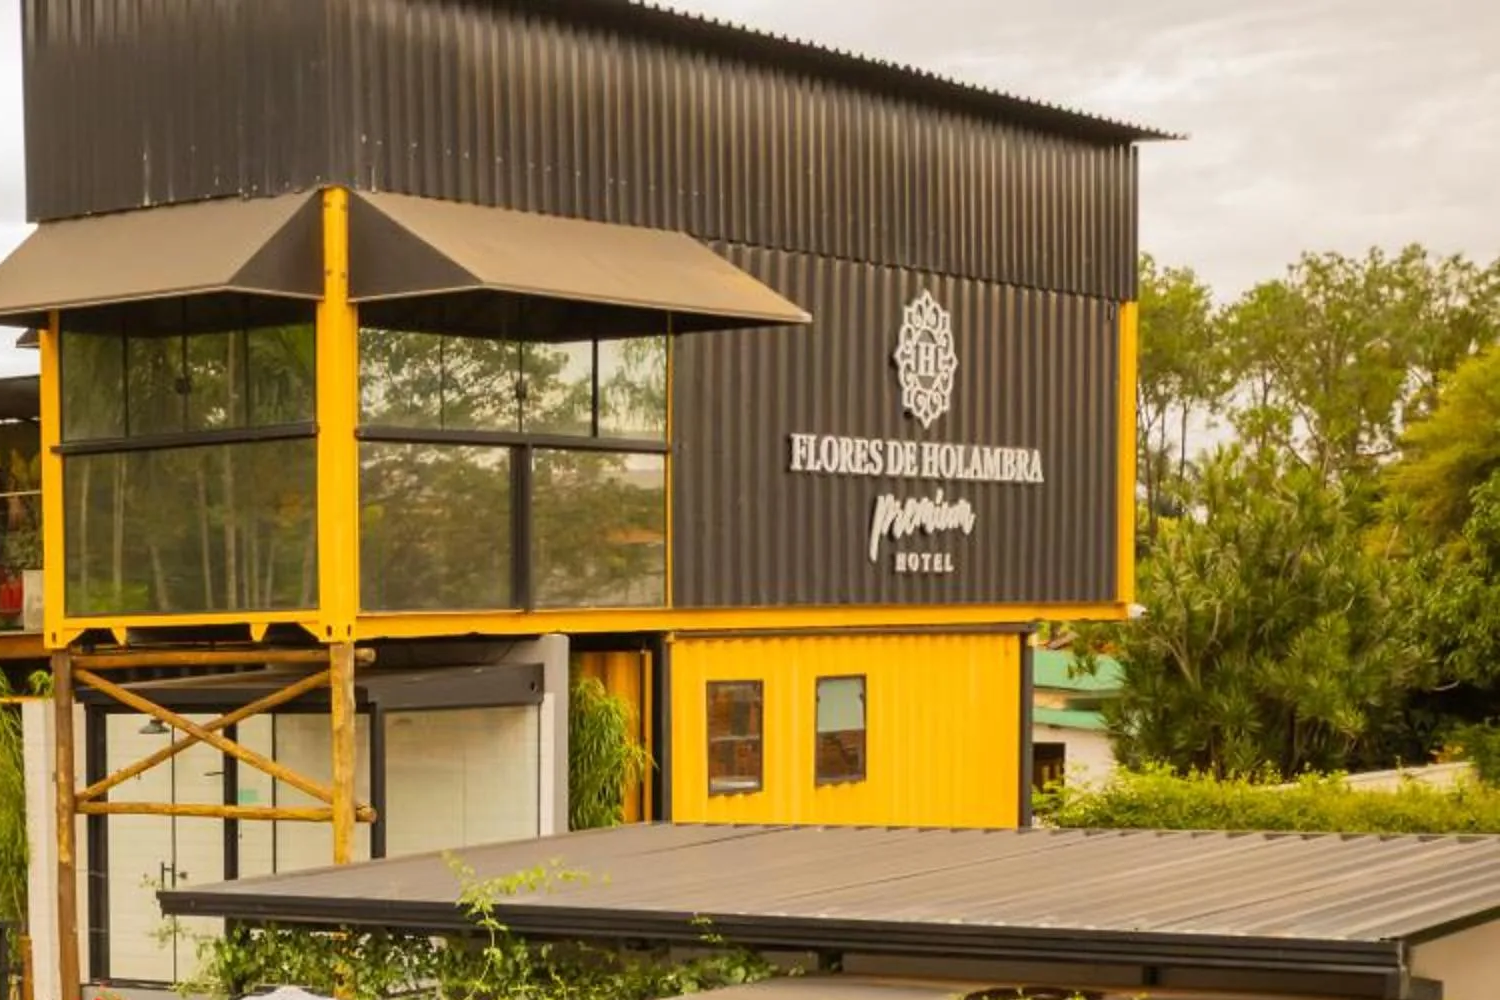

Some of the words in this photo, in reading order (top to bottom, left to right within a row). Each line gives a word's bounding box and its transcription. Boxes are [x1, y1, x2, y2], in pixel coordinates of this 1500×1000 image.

[790, 433, 884, 476] FLORES
[885, 440, 918, 477] DE
[920, 442, 1045, 482] HOLAMBRA
[895, 552, 954, 572] HOTEL
